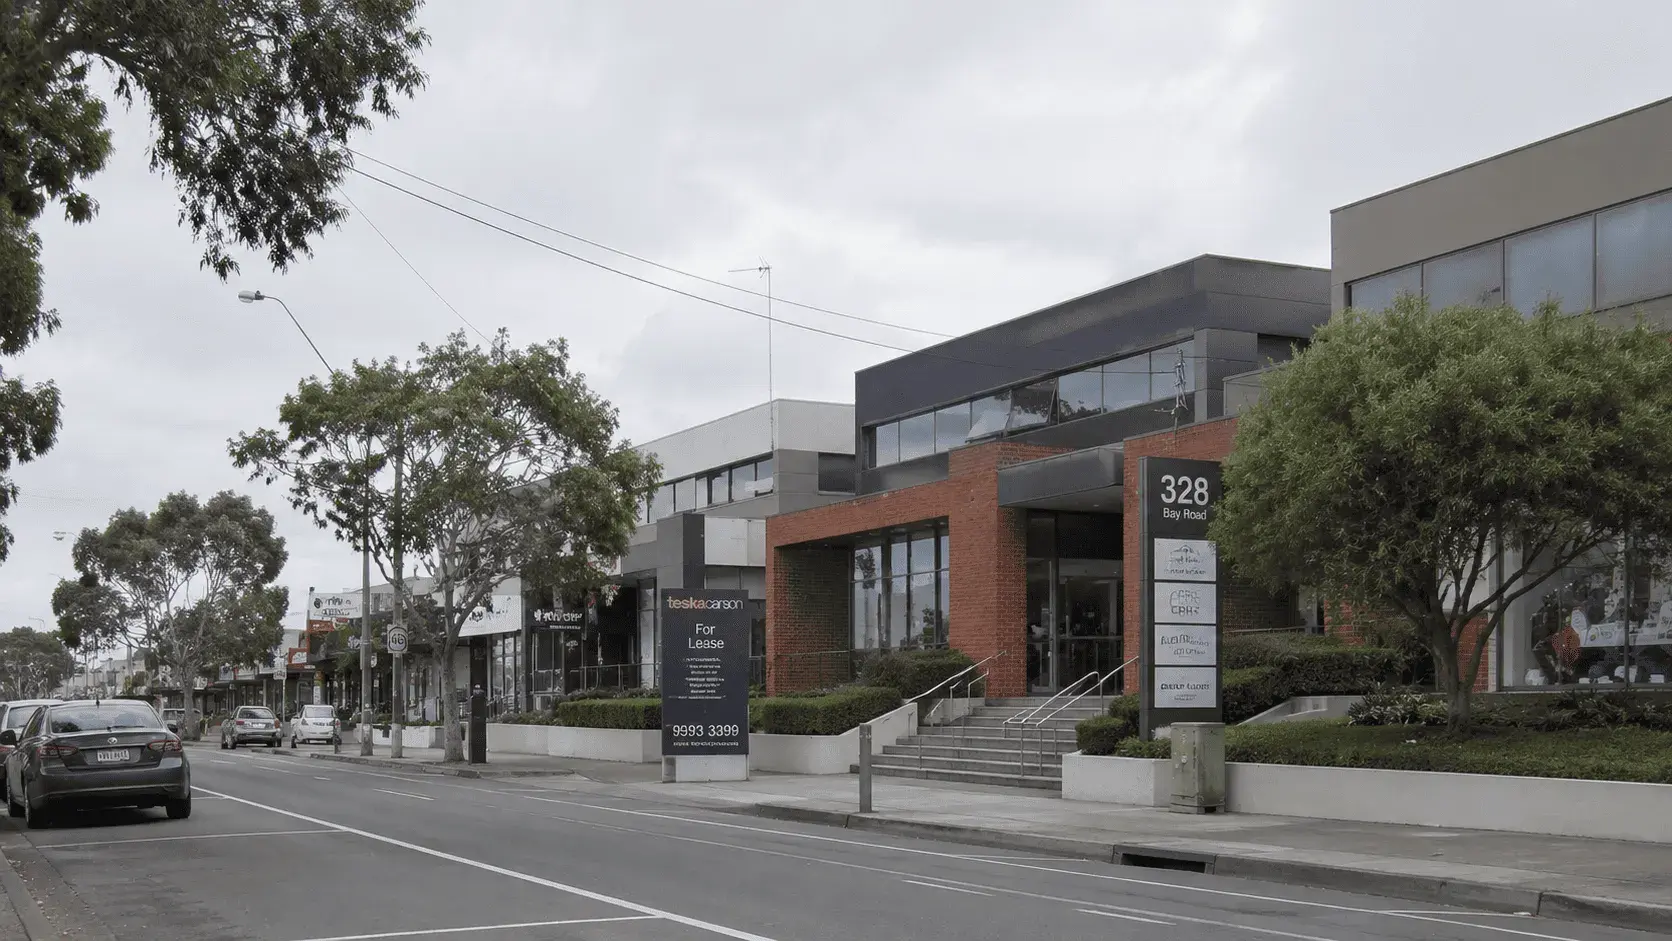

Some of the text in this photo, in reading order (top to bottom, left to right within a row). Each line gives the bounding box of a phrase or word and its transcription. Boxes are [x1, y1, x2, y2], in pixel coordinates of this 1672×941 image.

[1161, 474, 1209, 506] 328
[1163, 507, 1207, 520] Bay Road
[666, 595, 744, 610] teskacarson
[695, 623, 716, 635] For
[688, 637, 725, 649] Lease
[672, 724, 740, 737] 9993 3399
